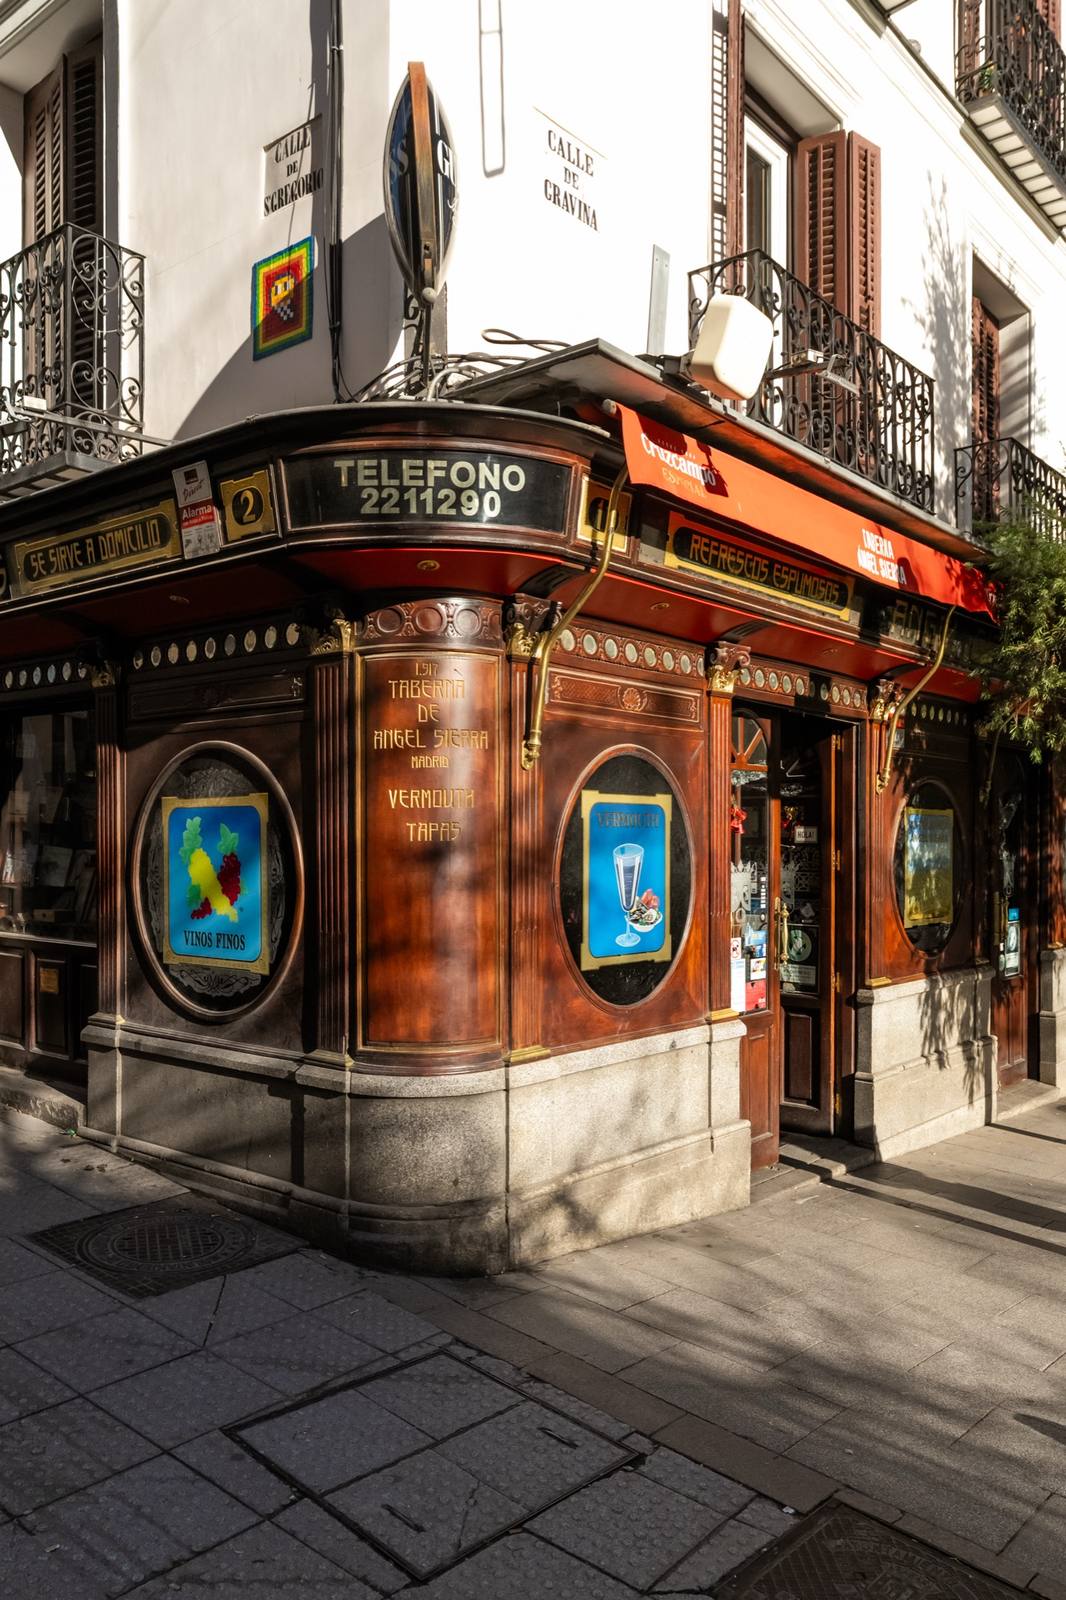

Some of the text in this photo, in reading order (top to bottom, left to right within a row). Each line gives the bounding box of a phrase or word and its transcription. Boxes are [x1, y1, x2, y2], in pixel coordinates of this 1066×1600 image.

[275, 126, 311, 163] CALLE
[548, 129, 594, 177] CALLE
[286, 160, 299, 177] DE
[563, 166, 580, 190] DE
[544, 178, 598, 231] GRAVINA
[640, 433, 717, 487] Cruzcampo
[334, 459, 526, 492] TELEFONO
[182, 504, 213, 521] Alarma
[240, 489, 256, 523] 2
[360, 488, 502, 518] 2211290
[30, 553, 47, 579] SE
[49, 544, 84, 574] SIRVE
[85, 538, 97, 563] A
[100, 519, 160, 561] DOMICILIO
[689, 533, 840, 604] REFRESCOS ESPUMOSOS
[388, 679, 465, 699] TABERNA
[418, 703, 441, 723] DE
[373, 729, 489, 750] ANGEL SIERRA
[411, 755, 449, 769] MADRID
[388, 788, 475, 809] VERMOUTH
[406, 821, 461, 842] TAPAS
[595, 811, 660, 829] VERMOUTH
[183, 929, 246, 951] VINOS FINOS
